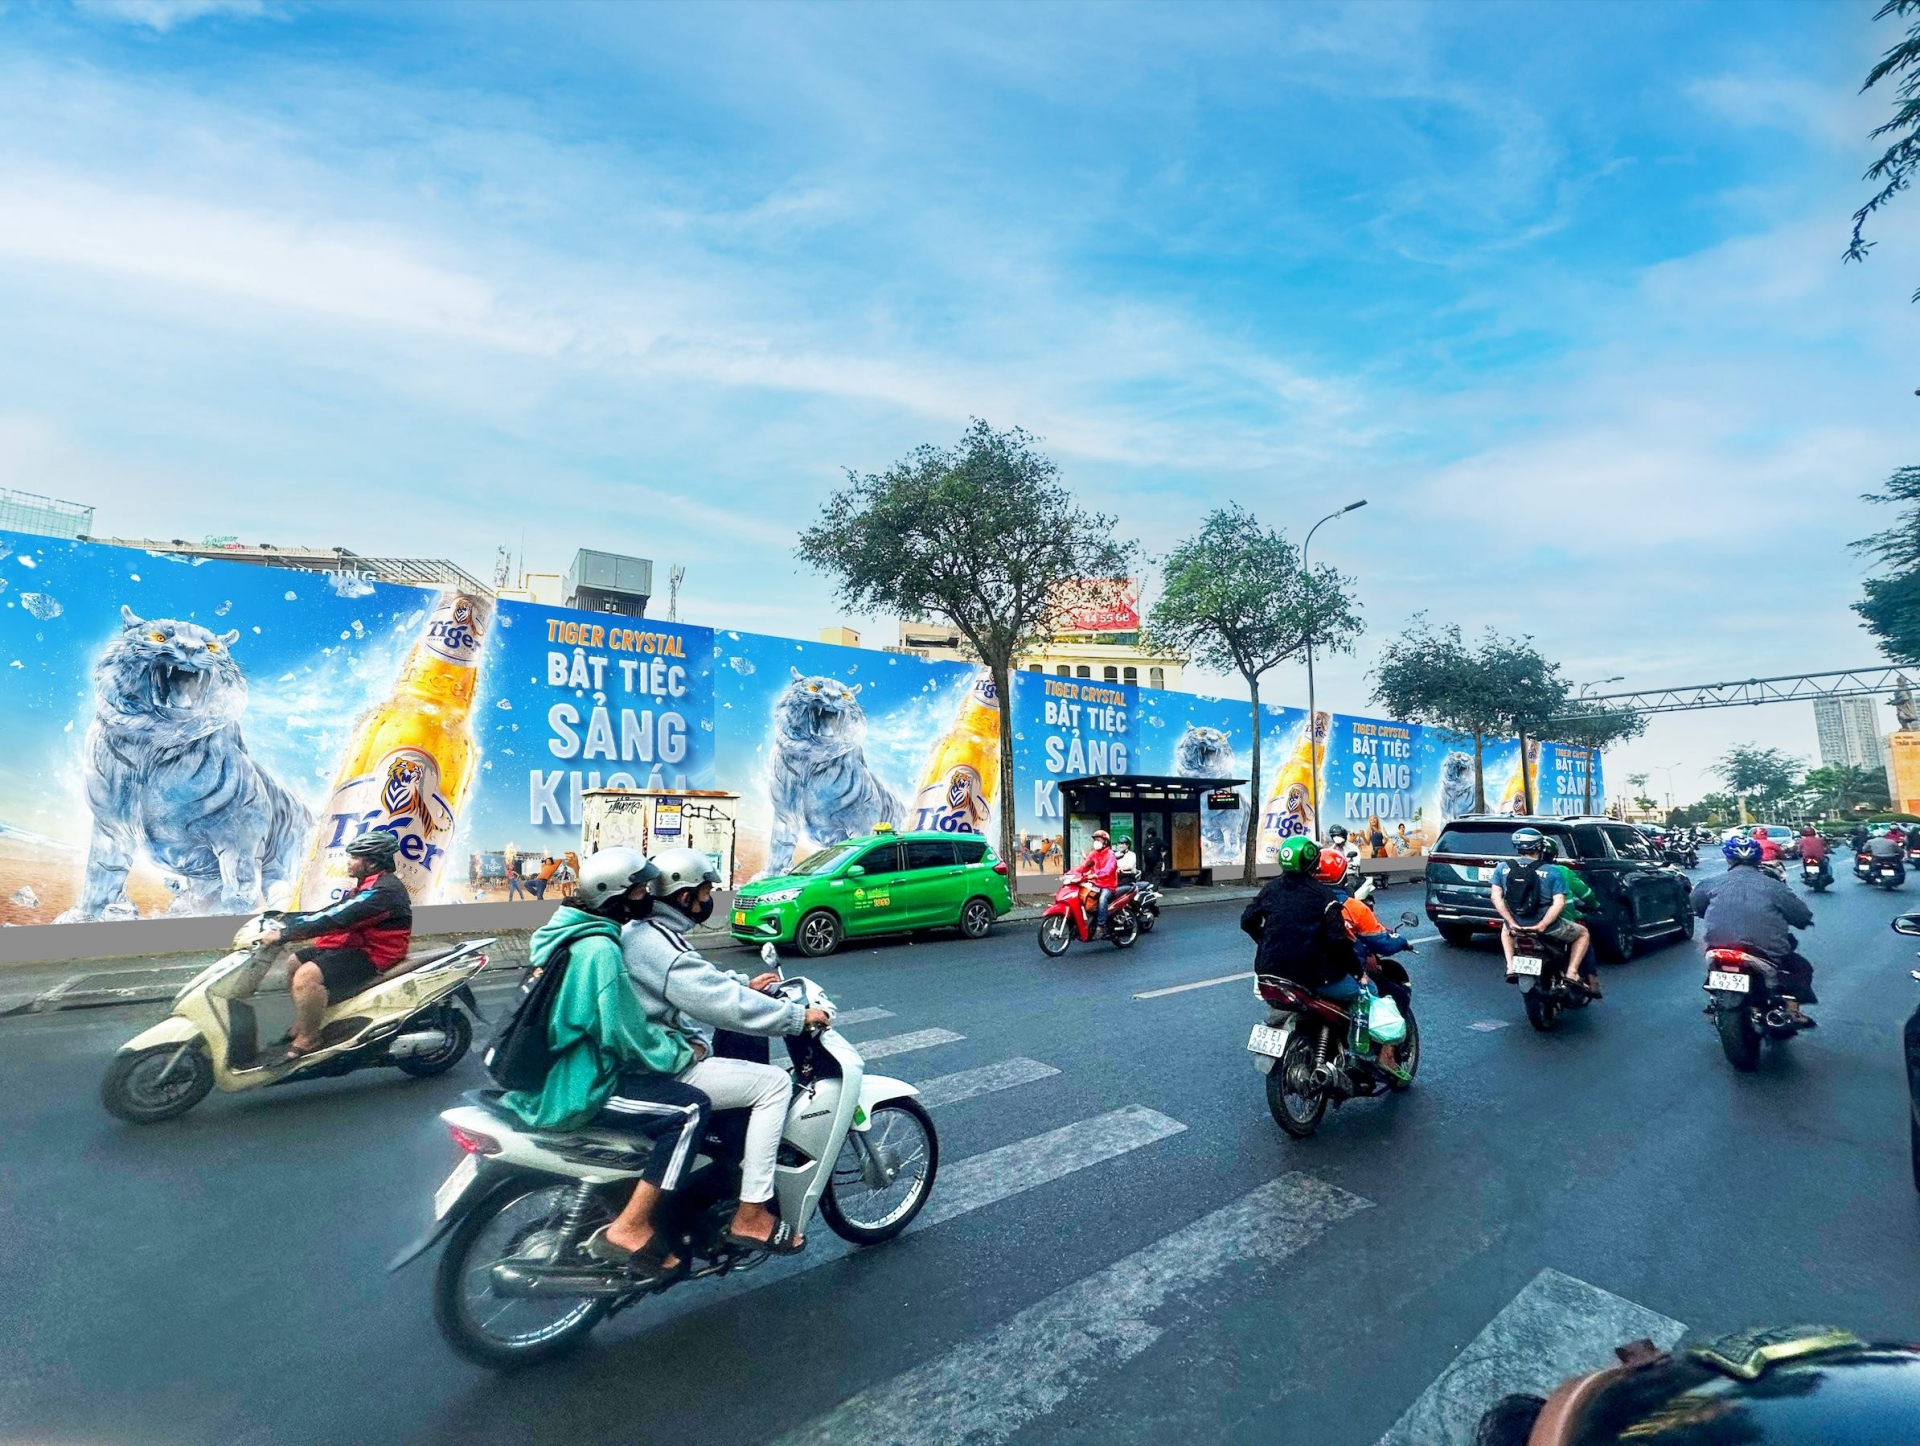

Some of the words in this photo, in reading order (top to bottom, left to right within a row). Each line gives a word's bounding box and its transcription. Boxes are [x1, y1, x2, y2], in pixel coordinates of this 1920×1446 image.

[427, 620, 482, 651] Tiger
[547, 619, 605, 647] TIGER
[609, 628, 686, 658] CRYSTAL
[547, 647, 608, 698] BẬT
[619, 657, 686, 705] TIỆC
[1044, 680, 1079, 699] TIGER
[1081, 686, 1126, 707] CRYSTAL
[548, 692, 687, 763] SẢNG
[1045, 699, 1081, 733] BẬT
[1087, 706, 1127, 738] TIỆC
[1352, 723, 1377, 736] TIGER
[1378, 726, 1410, 739] CRYSTAL
[1045, 729, 1127, 775] SẢNG
[1353, 736, 1378, 759] BẬT
[1382, 739, 1410, 762] TIỆC
[1353, 756, 1410, 789] SẢNG
[1345, 789, 1410, 818] KHOÁI
[1264, 811, 1311, 838] Tiger
[800, 1109, 831, 1120] HONDA
